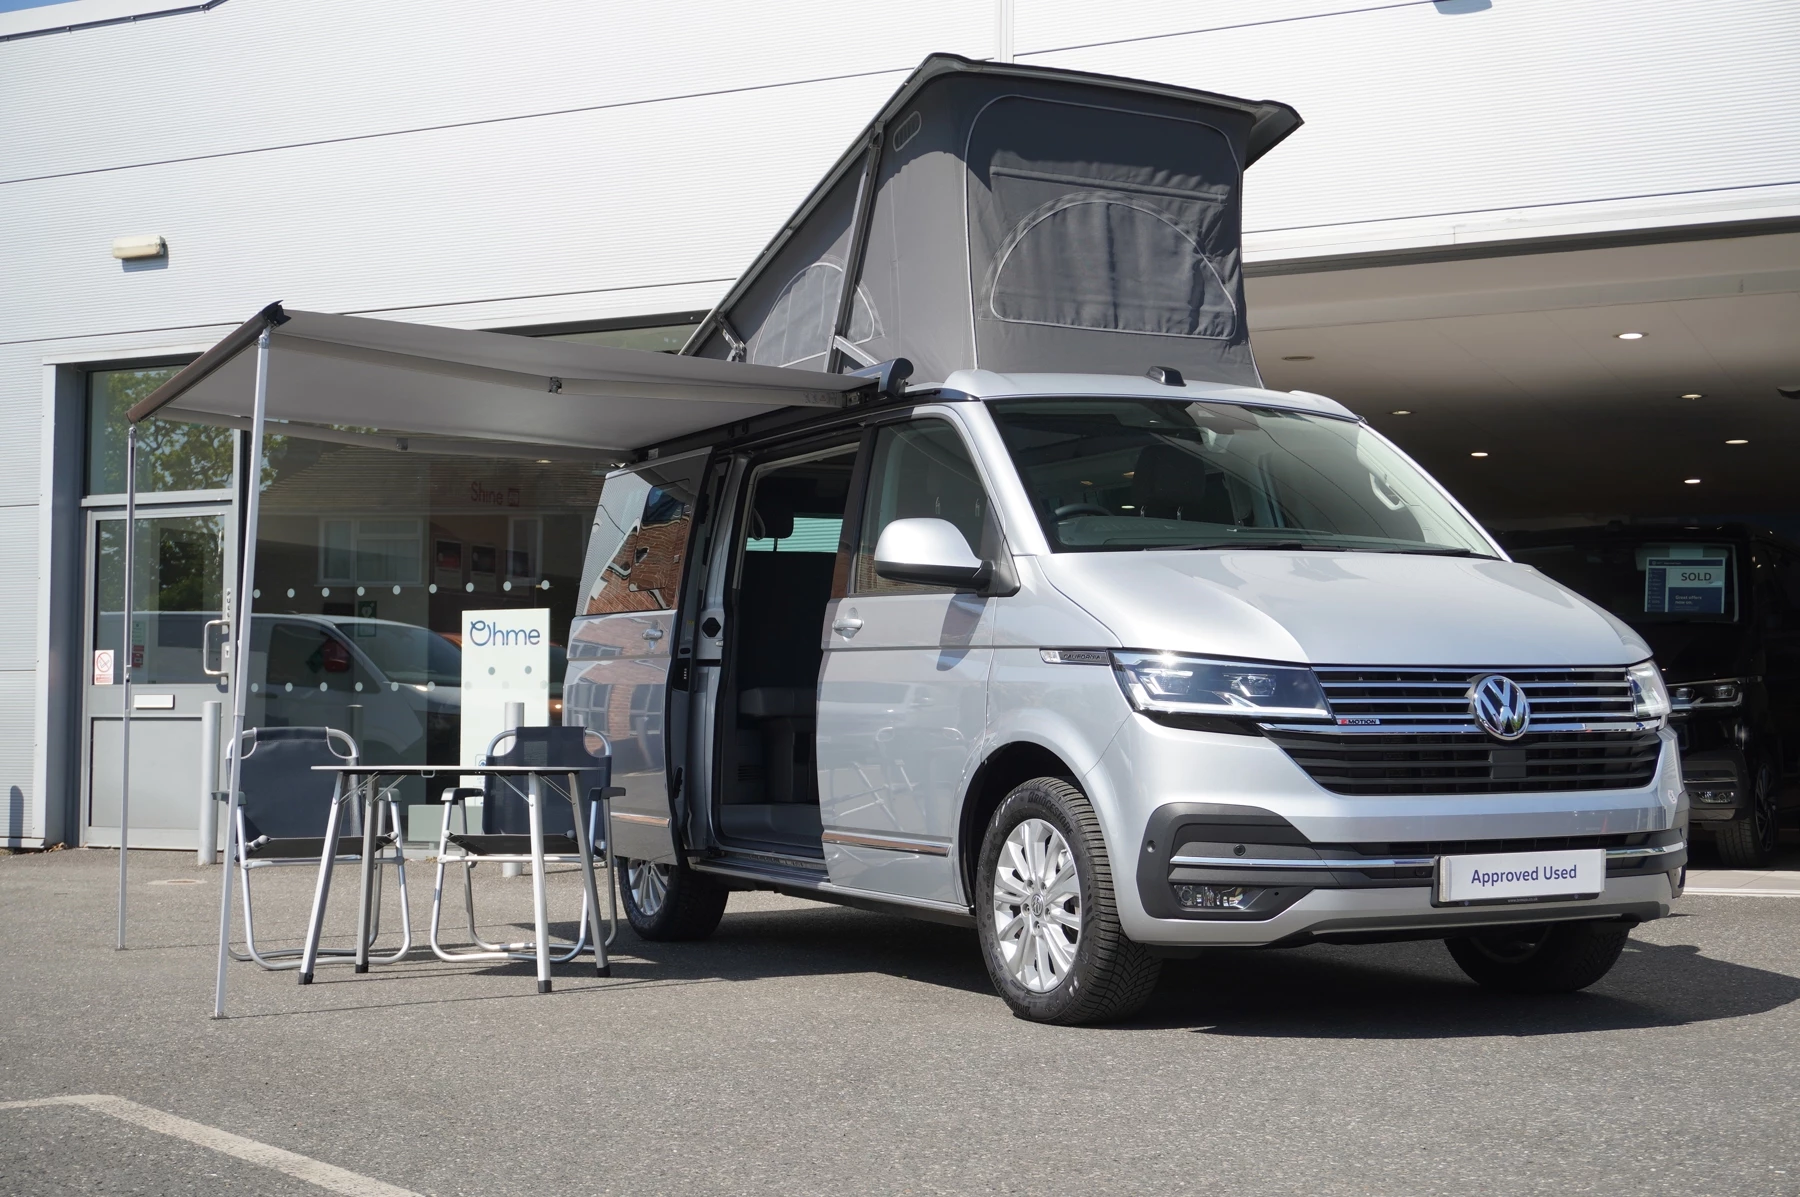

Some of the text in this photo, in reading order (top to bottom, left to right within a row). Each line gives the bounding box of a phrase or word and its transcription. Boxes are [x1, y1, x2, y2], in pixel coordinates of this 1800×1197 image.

[470, 481, 504, 505] Shine
[1681, 572, 1712, 582] SOLD
[470, 620, 541, 647] Ohme
[1028, 791, 1075, 837] BRIDGESTONE
[1471, 864, 1577, 887] Approved Used
